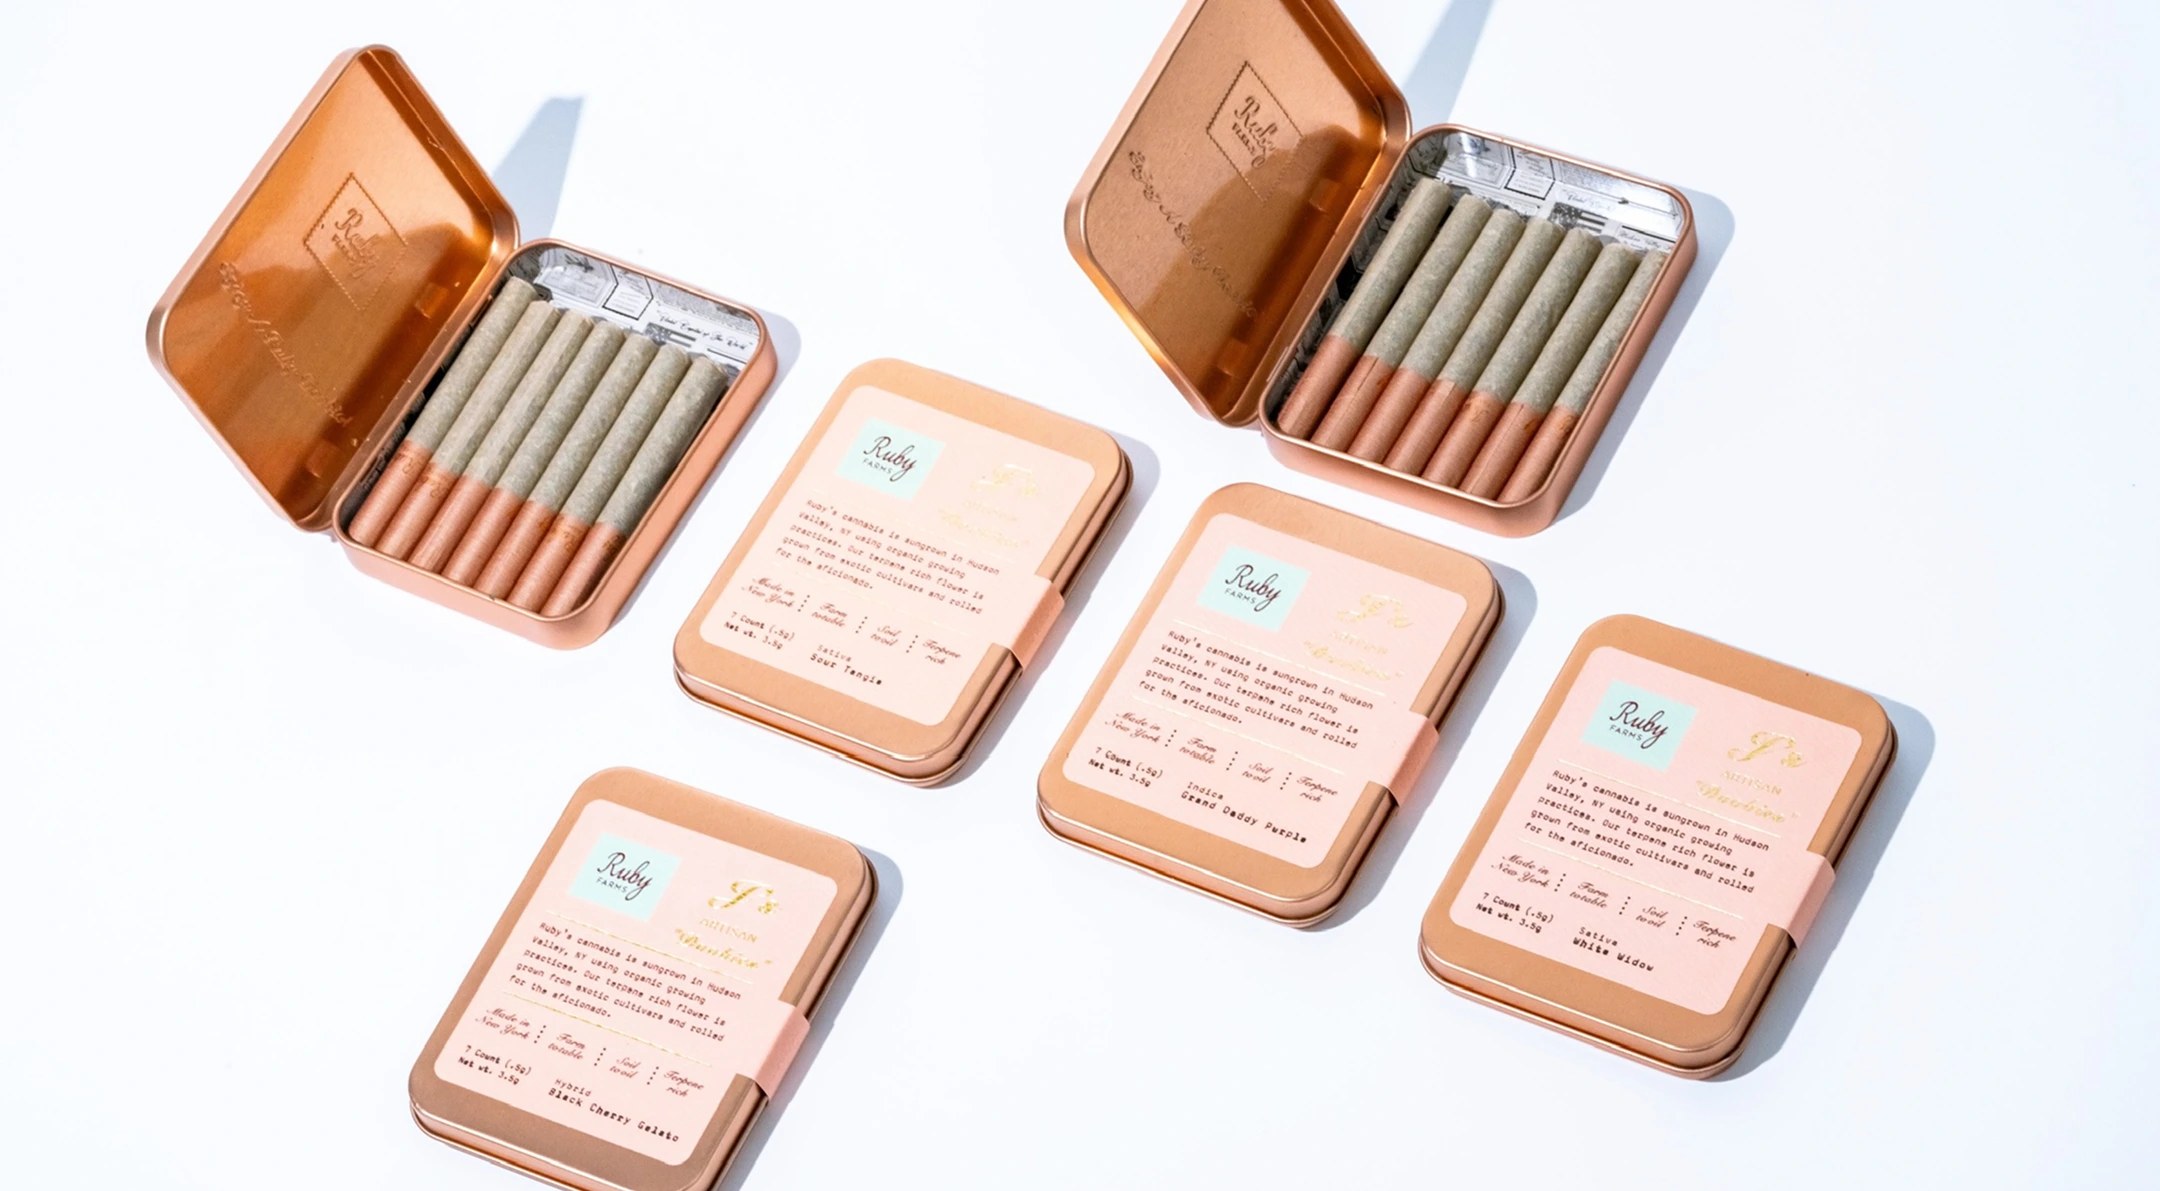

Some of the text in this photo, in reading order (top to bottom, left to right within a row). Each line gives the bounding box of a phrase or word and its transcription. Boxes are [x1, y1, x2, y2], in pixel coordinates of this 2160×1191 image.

[862, 435, 917, 482] Ruby
[862, 457, 893, 474] FARMS
[1224, 563, 1282, 612] Ruby
[1224, 587, 1256, 604] FARMS
[1138, 679, 1156, 692] for
[1160, 688, 1178, 701] the
[1205, 645, 1251, 666] cannabis
[1255, 662, 1268, 672] is
[1271, 669, 1318, 690] sungrown
[1321, 685, 1335, 696] in
[1338, 692, 1374, 710] Hudson
[1220, 666, 1249, 682] using
[1253, 677, 1294, 697] organic
[1297, 693, 1338, 714] growing
[1213, 676, 1232, 689] Our
[1236, 685, 1275, 705] terpene
[1279, 702, 1303, 715] rich
[1307, 711, 1342, 728] flower
[1345, 724, 1359, 734] is
[1608, 700, 1669, 750] Ruby
[1609, 723, 1643, 741] FARMS
[1088, 757, 1105, 770] Net
[1095, 745, 1102, 754] 7
[1104, 749, 1132, 767] Count
[1186, 780, 1224, 800] Indica
[1180, 790, 1307, 843] Grand Daddy Purple
[1537, 795, 1755, 878] practices. Our terpene rich flower is
[1545, 782, 1733, 856] Valley, NY using organic growing
[1592, 785, 1640, 807] cannabis
[1644, 802, 1658, 813] is
[1662, 809, 1711, 832] sungrown
[1714, 827, 1728, 837] in
[1732, 833, 1769, 851] Hudson
[1524, 821, 1634, 867] for the aficionado.
[1530, 809, 1755, 893] grown from exotic cultivars and rolled
[596, 851, 653, 901] Ruby
[596, 876, 628, 893] FARMS
[1475, 902, 1542, 934] Net wt. 3.5g
[1482, 891, 1490, 900] 7
[1492, 895, 1521, 912] Count
[1572, 936, 1654, 972] White Widow
[1578, 926, 1618, 947] Sativa
[509, 973, 526, 986] for
[530, 982, 548, 994] the
[576, 937, 621, 958] cannabis
[624, 953, 638, 963] is
[641, 960, 687, 981] sungrown
[690, 976, 703, 986] in
[706, 982, 741, 1000] Hudson
[590, 958, 619, 974] using
[623, 969, 663, 988] organic
[666, 984, 706, 1006] growing
[515, 962, 725, 1042] grown from exotic cultivars and rolled
[583, 969, 601, 982] Our
[605, 977, 644, 998] terpene
[647, 994, 672, 1008] rich
[676, 1002, 710, 1021] flower
[713, 1016, 726, 1026] is
[458, 1055, 474, 1068] Net
[465, 1043, 472, 1053] 7
[474, 1048, 501, 1064] Count
[554, 1078, 592, 1097] Hybrid
[548, 1086, 679, 1142] Black Cherry Gelato
